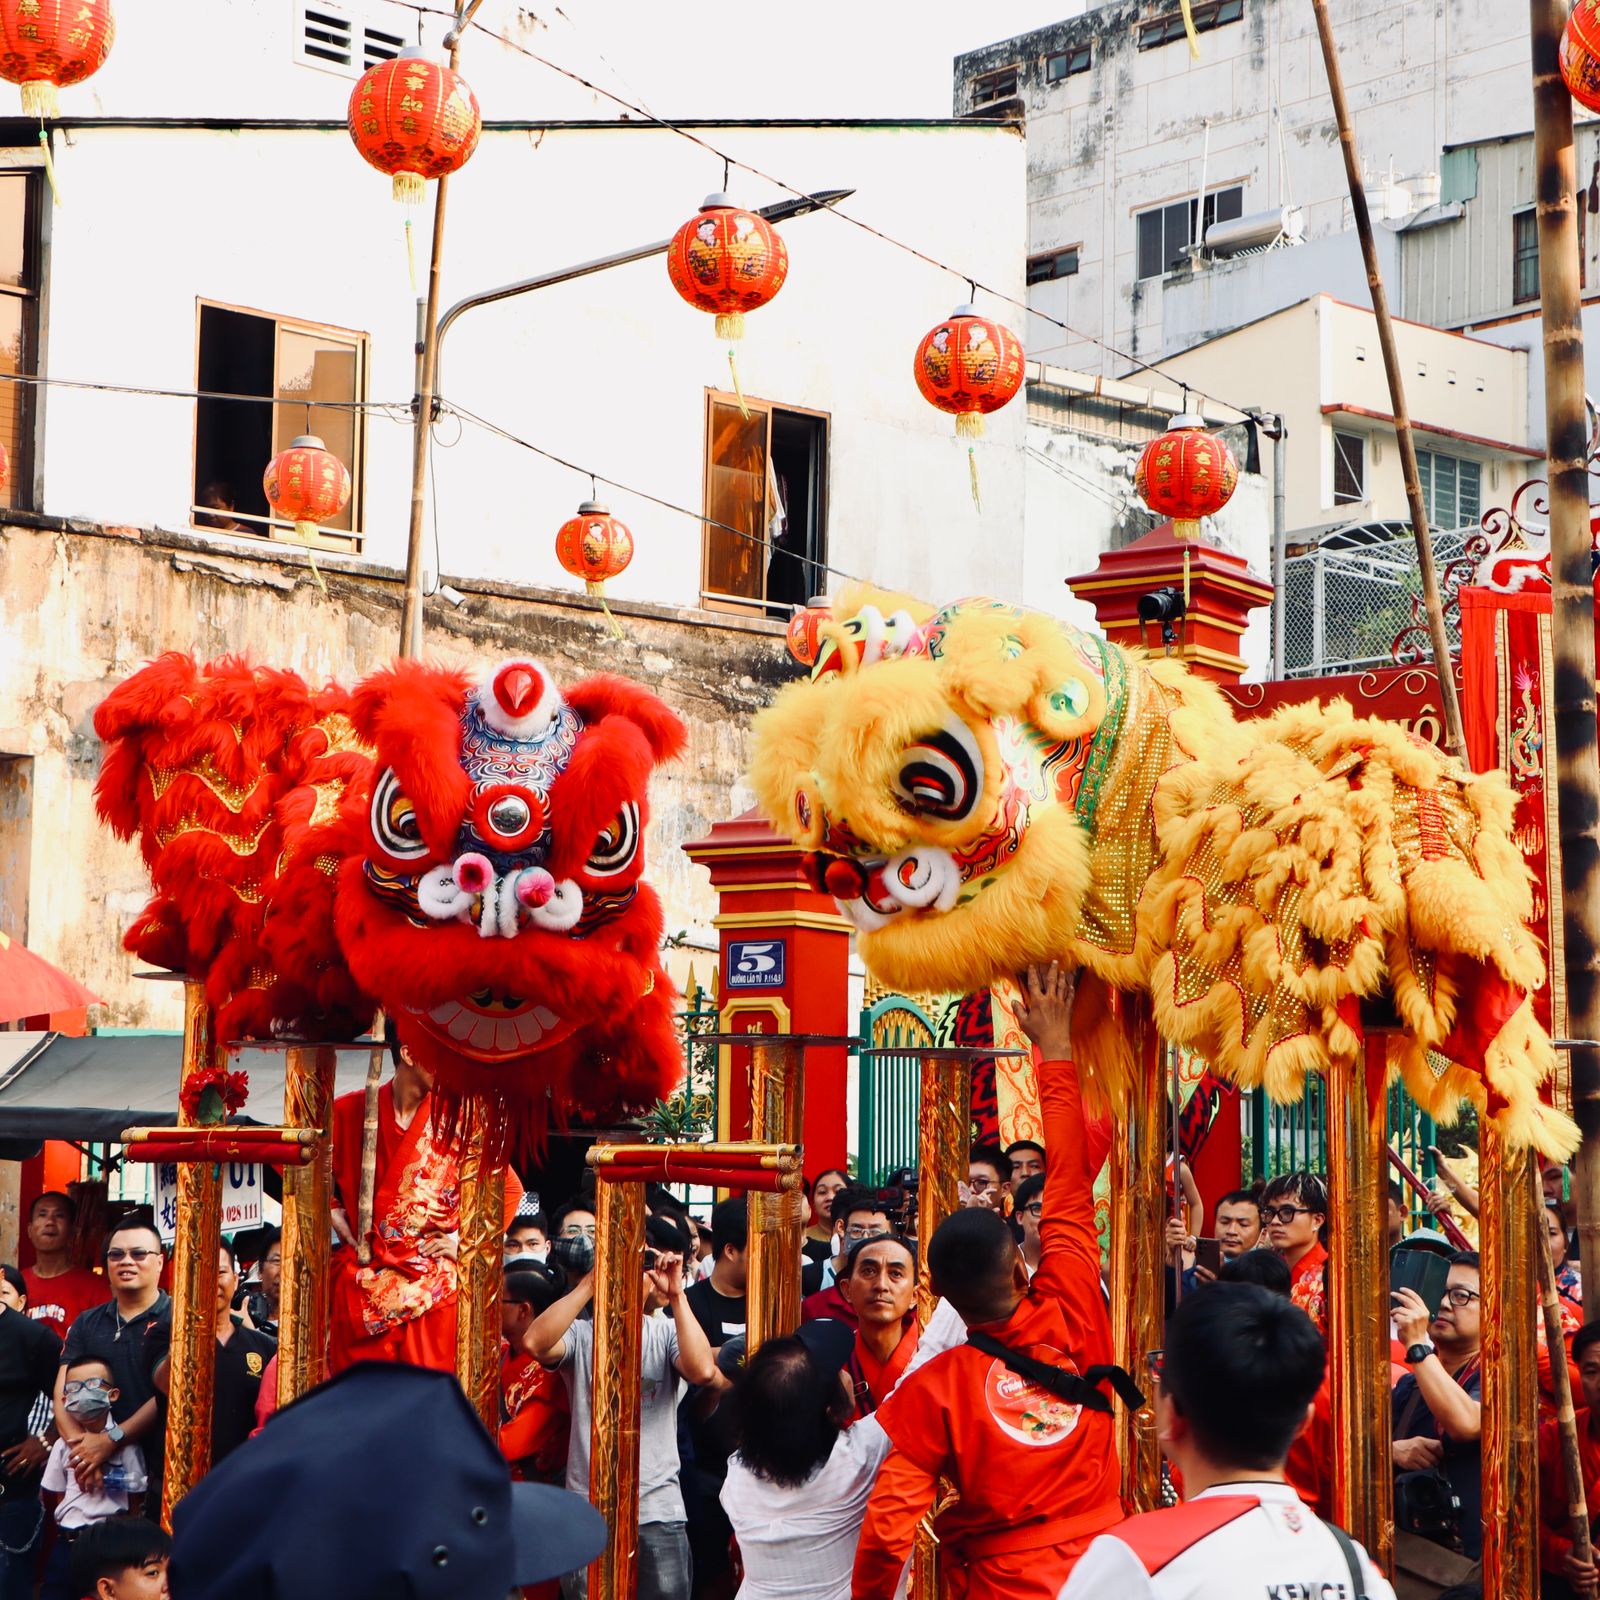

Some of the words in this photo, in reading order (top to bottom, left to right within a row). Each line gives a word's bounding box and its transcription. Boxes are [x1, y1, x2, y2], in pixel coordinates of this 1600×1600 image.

[737, 944, 776, 972] 5
[226, 1204, 242, 1222] 028
[243, 1202, 259, 1220] 111
